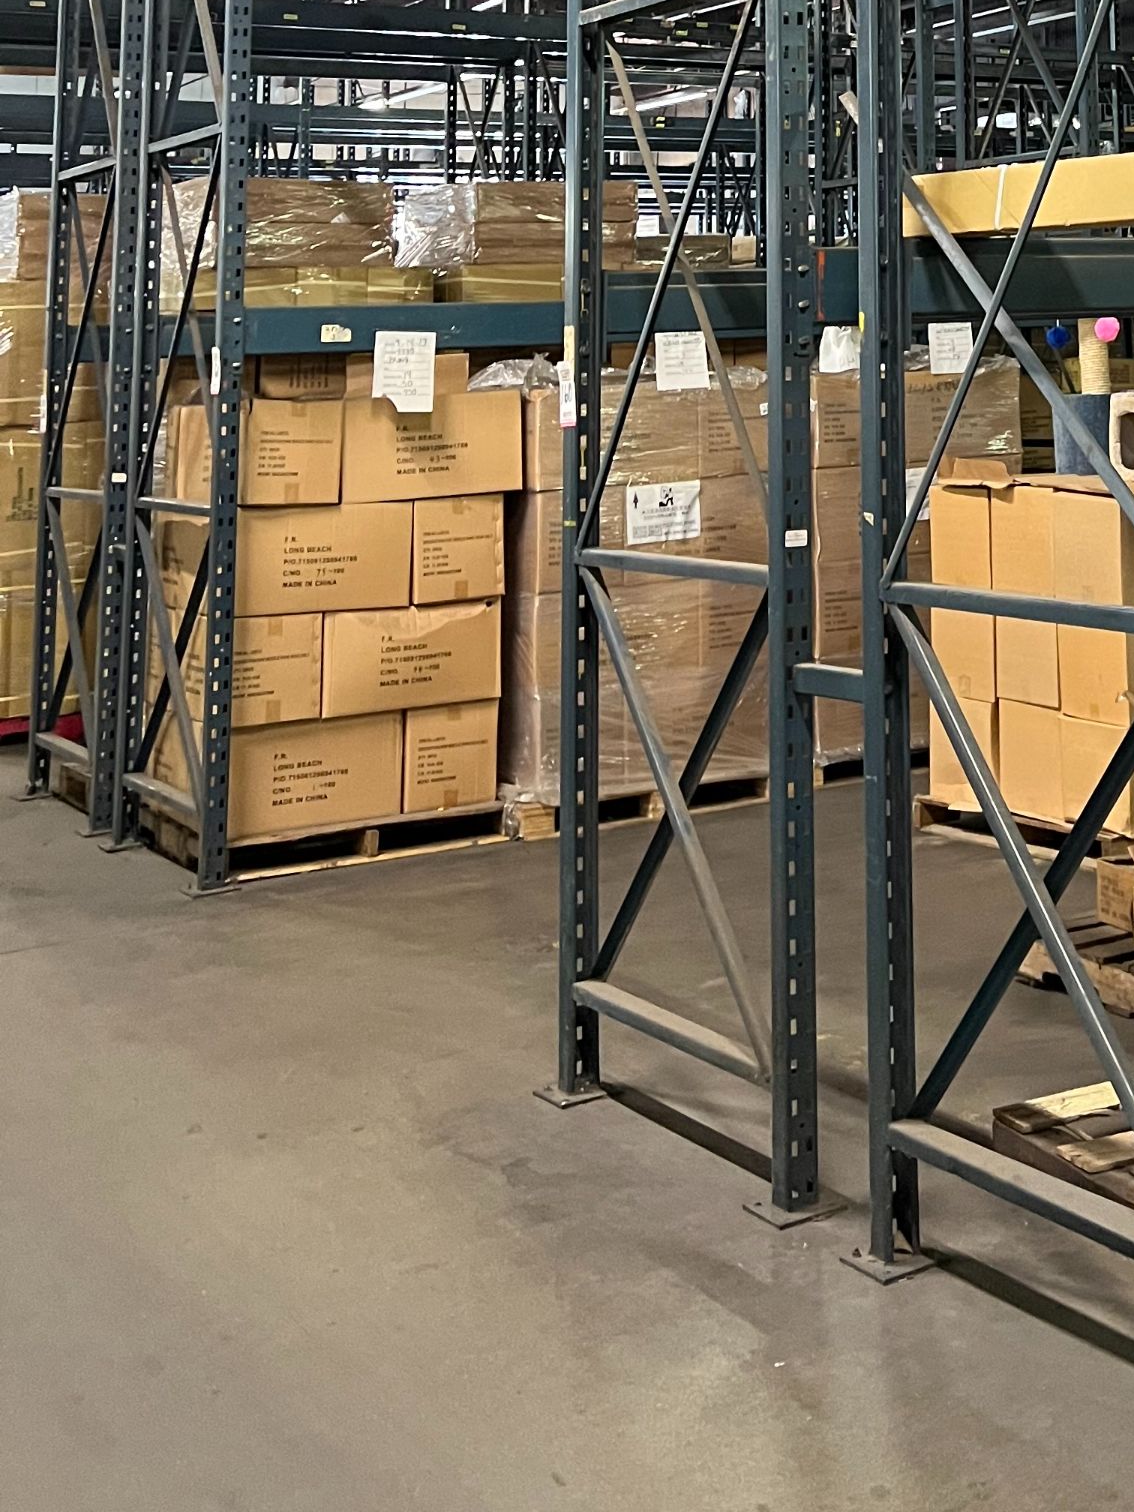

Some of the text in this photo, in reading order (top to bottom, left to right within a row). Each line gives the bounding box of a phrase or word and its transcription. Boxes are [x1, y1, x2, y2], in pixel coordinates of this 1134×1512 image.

[315, 578, 337, 586] CHINA
[381, 643, 427, 653] LONG BEACH
[380, 679, 399, 687] MADE
[411, 675, 432, 683] CHINA
[274, 760, 322, 772] LONG BEACH
[272, 797, 293, 806] MADE
[305, 793, 328, 802] CHINA
